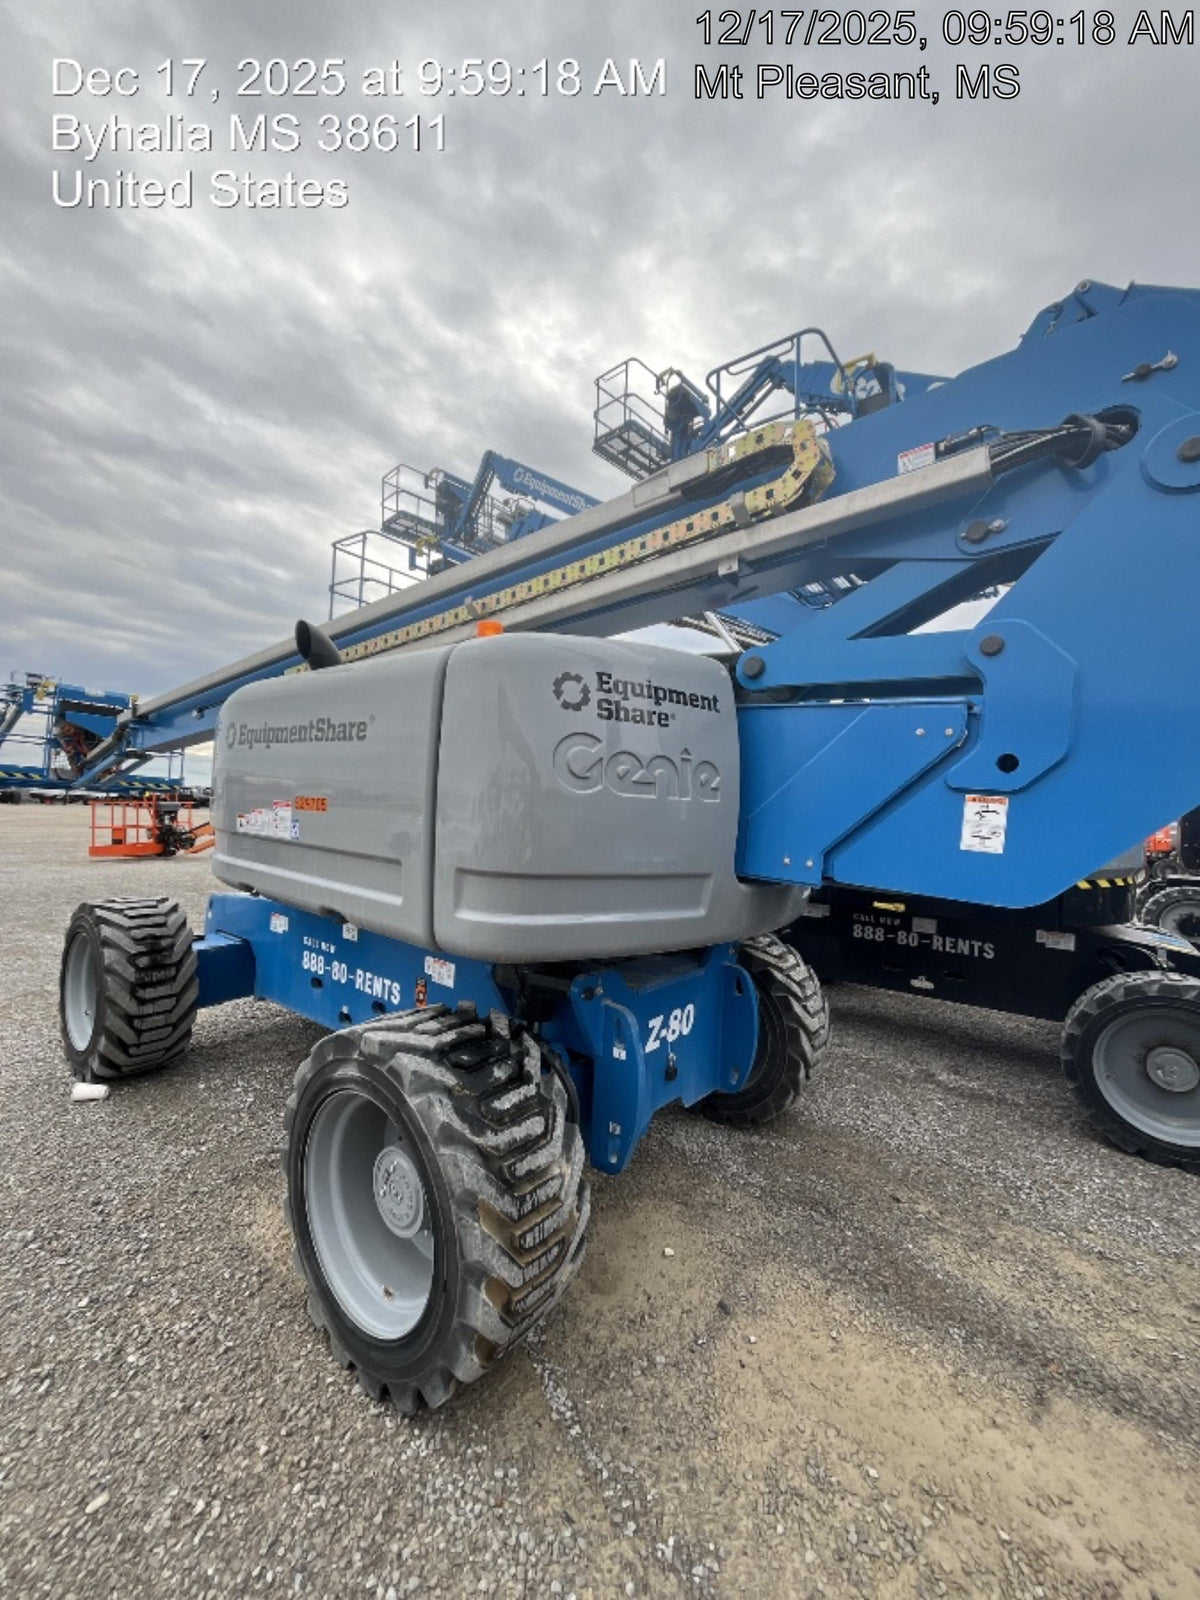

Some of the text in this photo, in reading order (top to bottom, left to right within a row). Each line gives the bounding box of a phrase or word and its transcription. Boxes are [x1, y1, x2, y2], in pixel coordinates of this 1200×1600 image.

[596, 671, 721, 713] Equipment
[597, 698, 669, 727] Share
[237, 717, 368, 749] EquipmentShare
[553, 731, 721, 802] Genie
[852, 923, 995, 959] 888-80-RENTS
[302, 950, 401, 1006] 888-80-RENTS
[645, 1003, 695, 1053] Z-80
